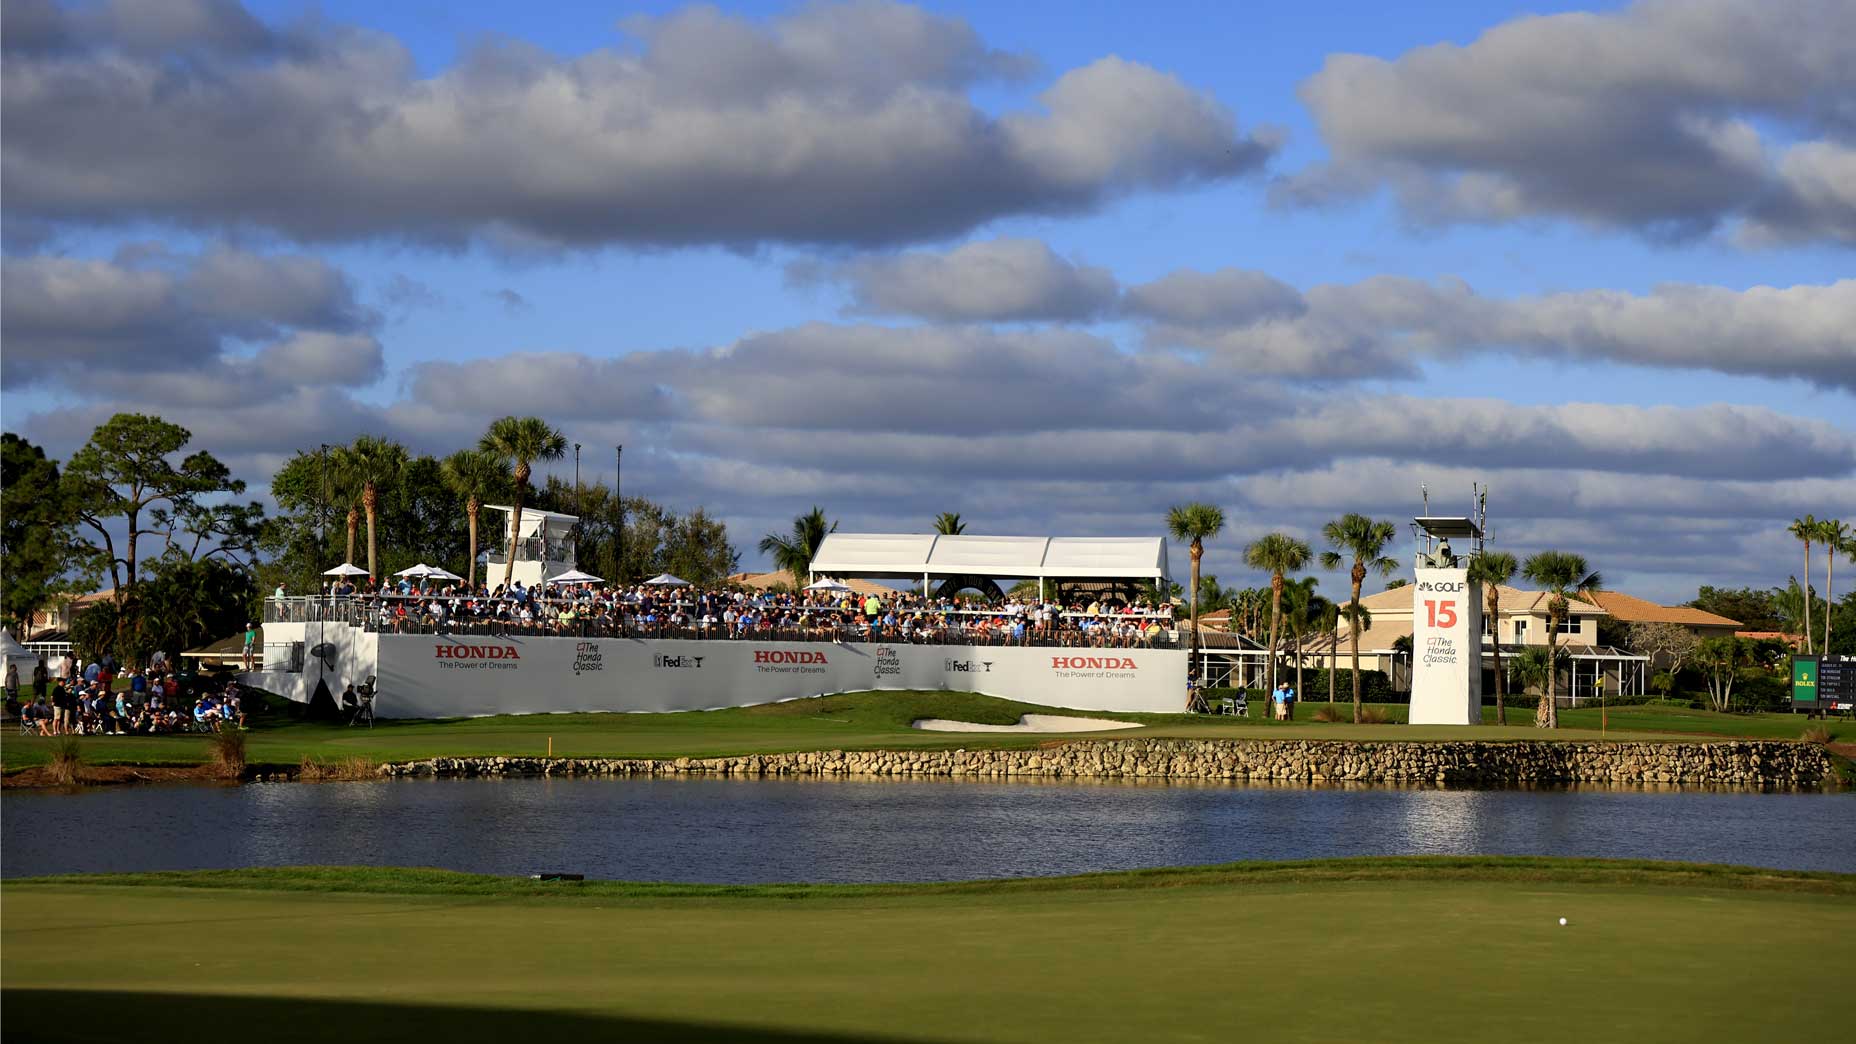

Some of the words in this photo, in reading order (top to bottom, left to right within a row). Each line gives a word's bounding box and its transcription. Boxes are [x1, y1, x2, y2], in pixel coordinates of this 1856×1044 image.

[1434, 582, 1464, 592] GOLF
[1424, 600, 1457, 628] 15
[1437, 638, 1452, 646] The
[435, 645, 521, 659] HONDA
[585, 643, 599, 652] The
[884, 647, 897, 657] The
[1427, 647, 1456, 655] Honda
[577, 652, 602, 662] Honda
[663, 655, 693, 668] FedEx
[754, 650, 828, 664] HONDA
[877, 657, 900, 666] Honda
[1423, 655, 1457, 663] Classic
[439, 661, 453, 669] The
[454, 661, 478, 669] Power
[479, 661, 487, 669] of
[573, 662, 603, 671] Classic
[953, 660, 981, 672] FedEx
[1052, 657, 1138, 669] HONDA
[801, 666, 826, 674] Dreams
[874, 665, 901, 675] Classic
